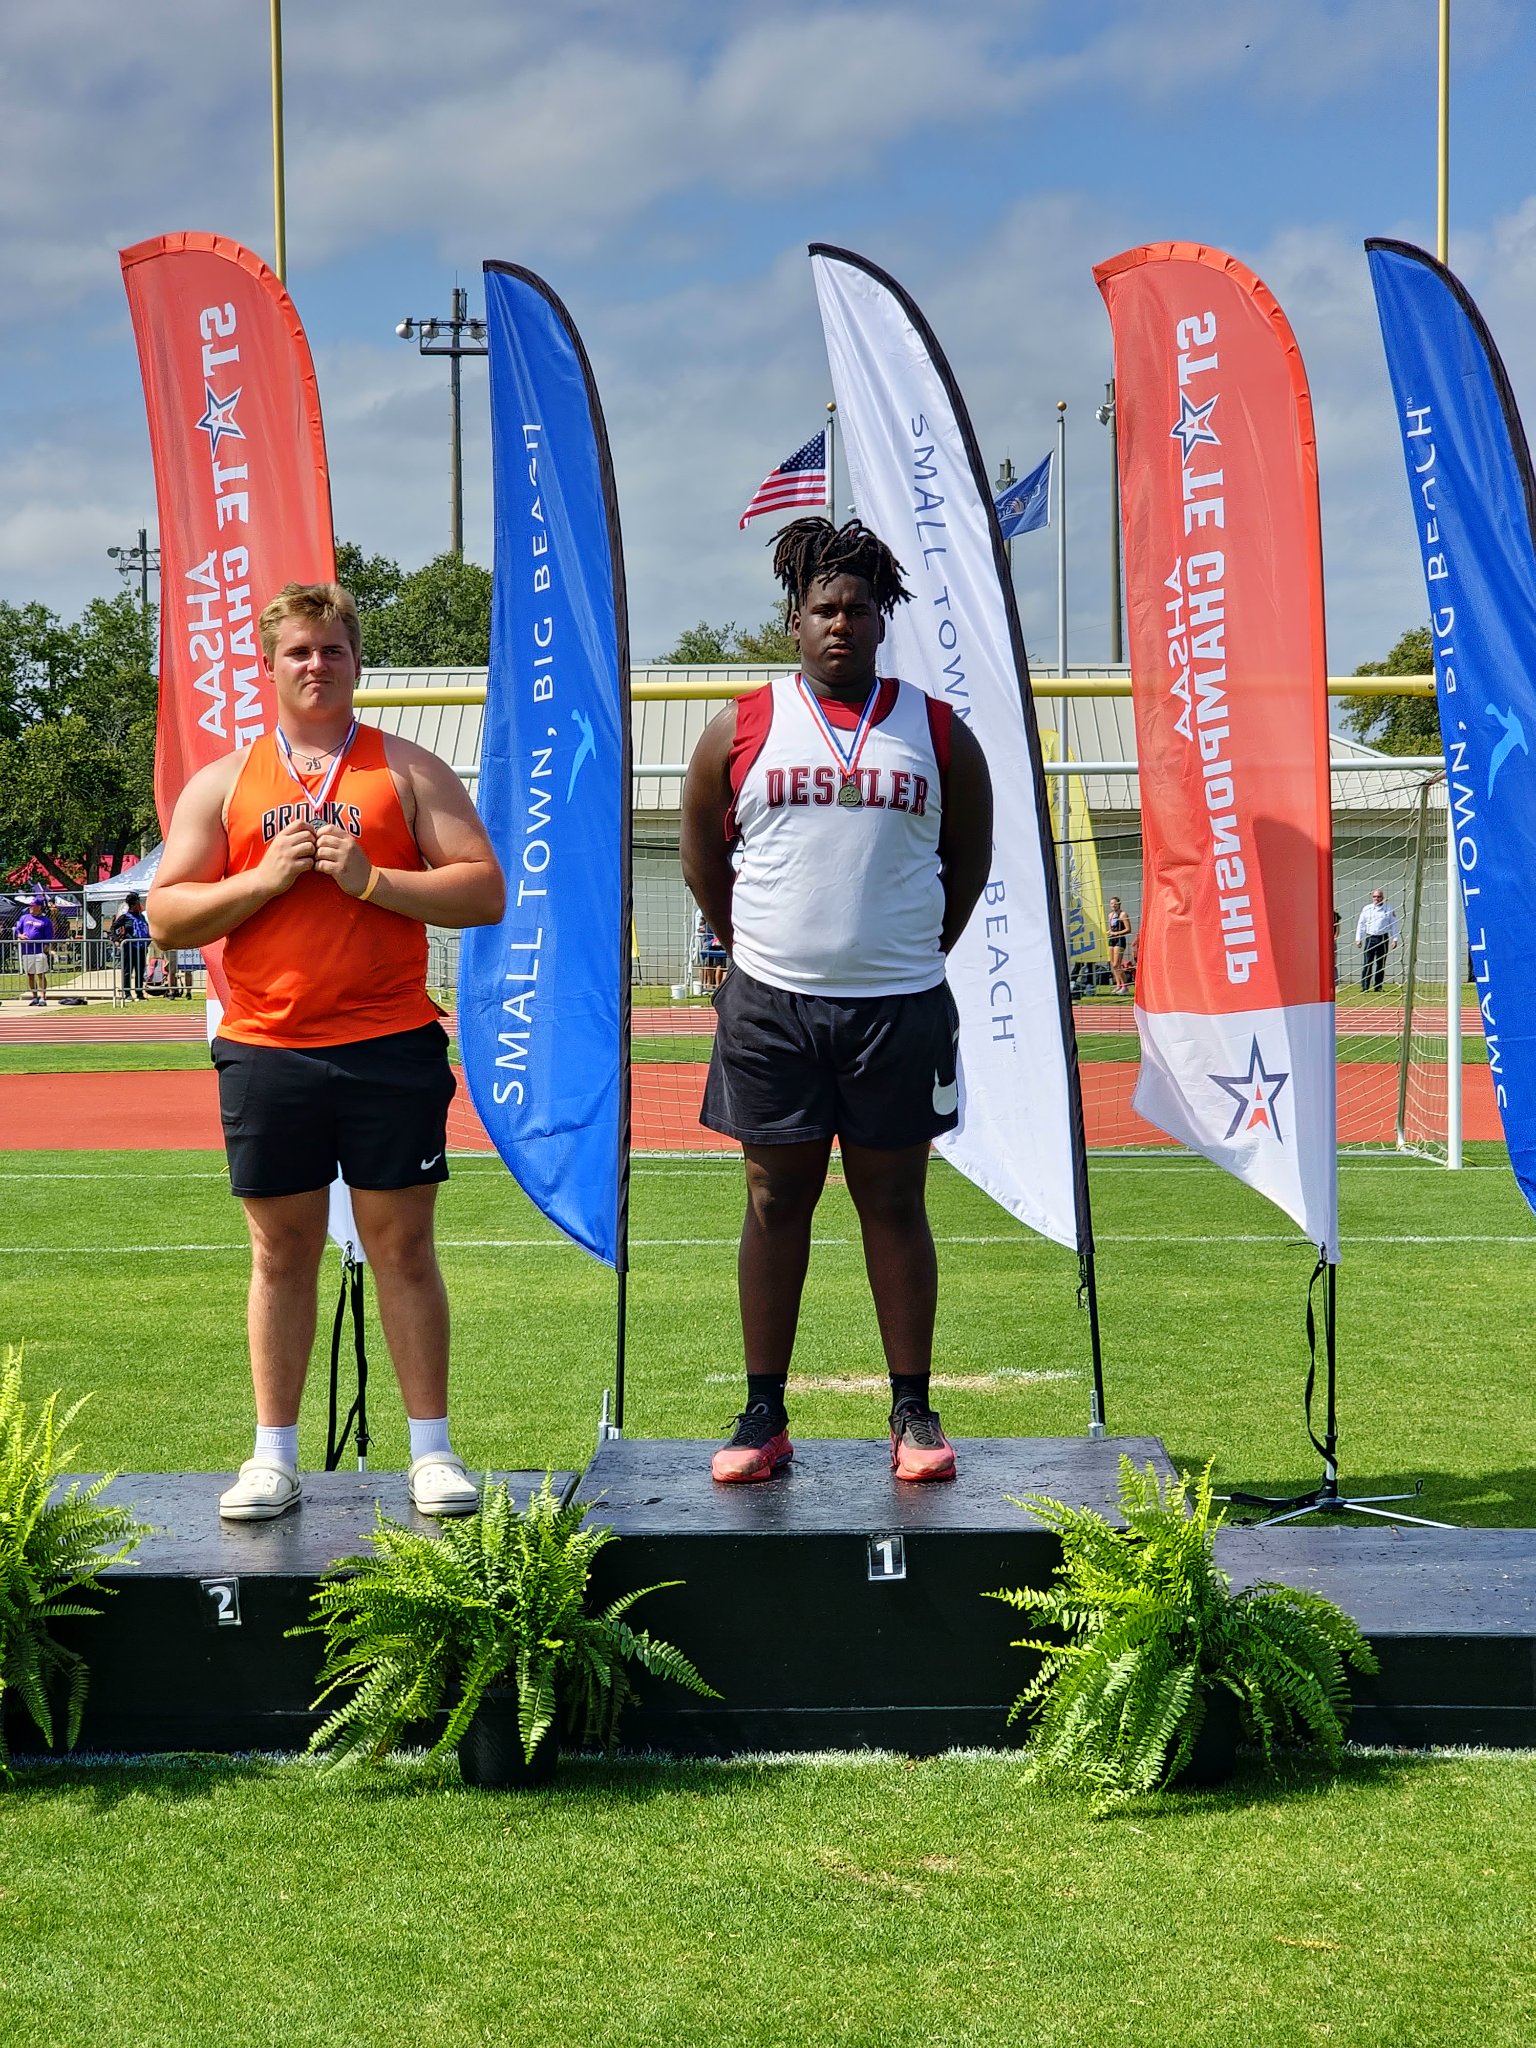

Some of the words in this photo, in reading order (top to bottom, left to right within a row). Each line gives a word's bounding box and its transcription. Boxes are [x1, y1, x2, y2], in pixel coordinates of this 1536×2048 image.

[911, 413, 947, 570] SMALL
[493, 927, 543, 1106] SMALL
[533, 616, 554, 704] BIG
[208, 1585, 235, 1620] 2
[876, 1540, 894, 1574] 1
